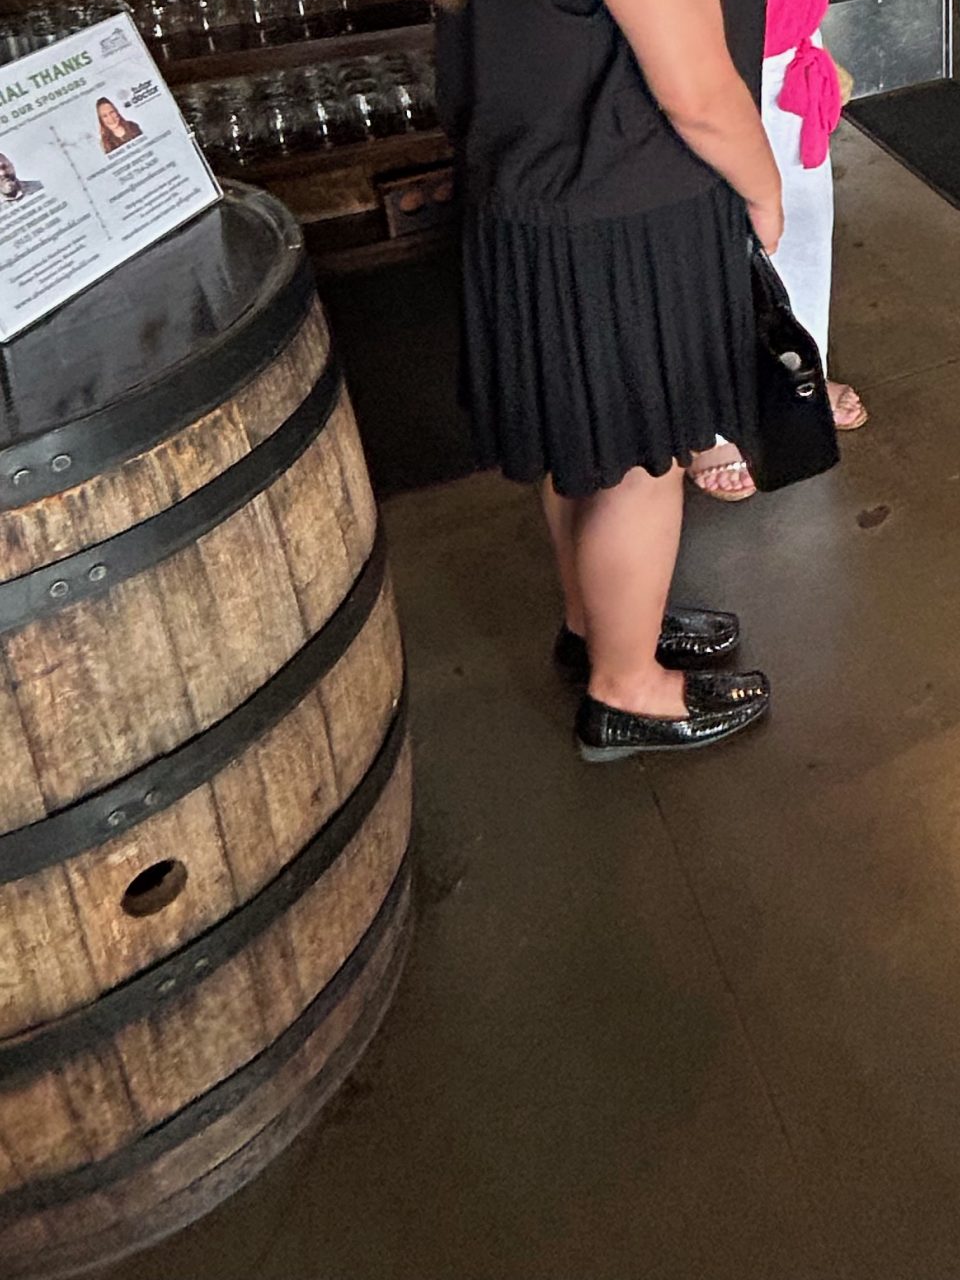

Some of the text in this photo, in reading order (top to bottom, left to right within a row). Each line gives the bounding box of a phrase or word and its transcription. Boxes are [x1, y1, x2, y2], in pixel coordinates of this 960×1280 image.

[0, 50, 93, 108] IAL THANKS
[11, 103, 34, 119] OUR
[35, 76, 87, 108] SPONSORS
[131, 85, 158, 104] doctor
